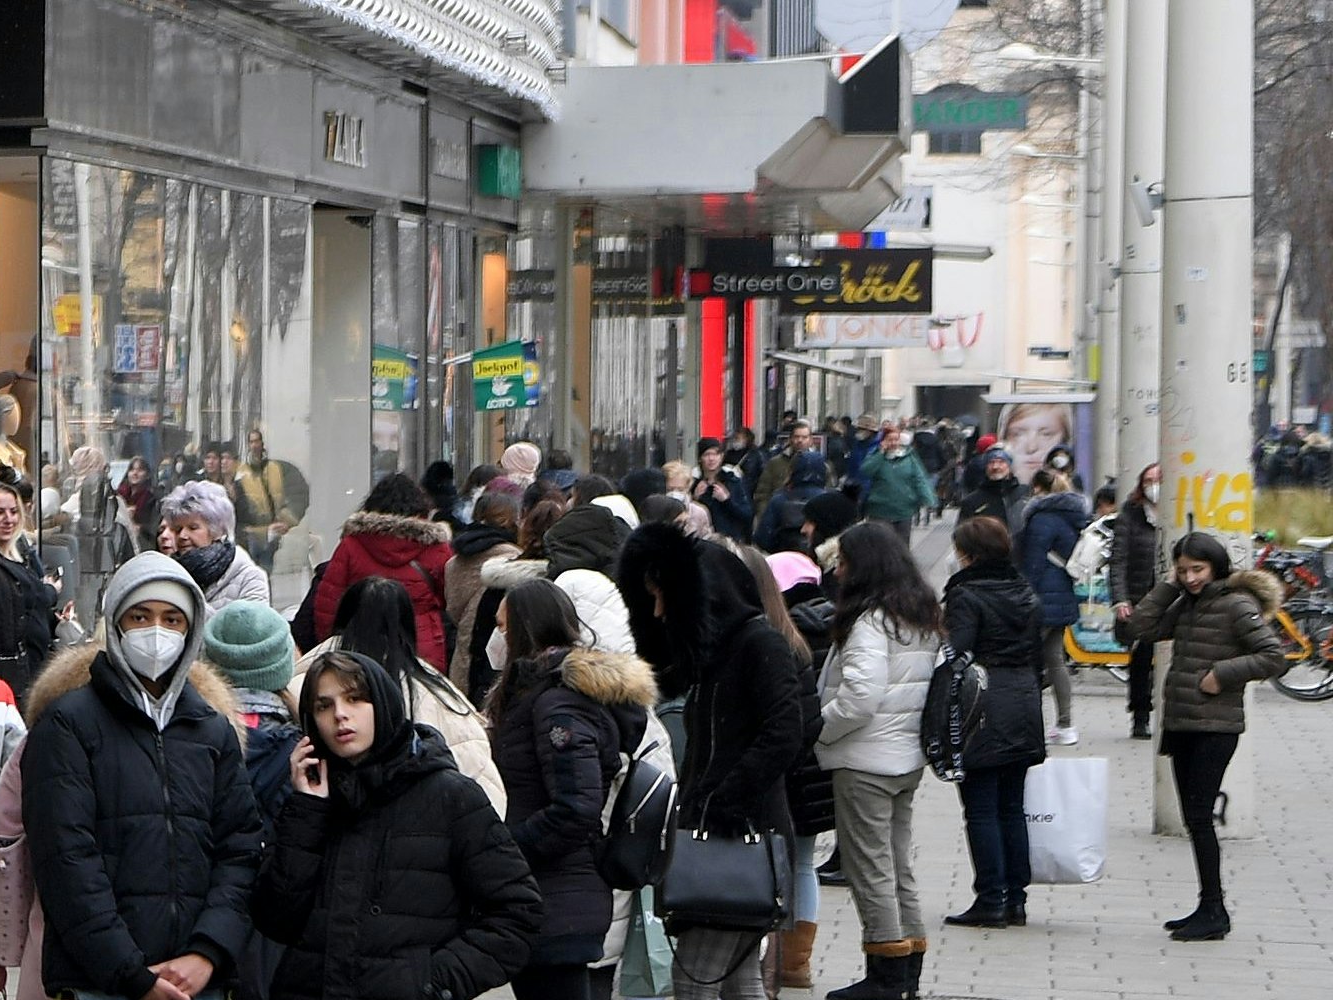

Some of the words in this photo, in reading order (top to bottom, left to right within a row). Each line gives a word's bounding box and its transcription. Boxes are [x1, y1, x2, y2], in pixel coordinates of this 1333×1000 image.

[713, 273, 782, 294] Street
[787, 273, 835, 291] One
[475, 361, 519, 376] Jackpot
